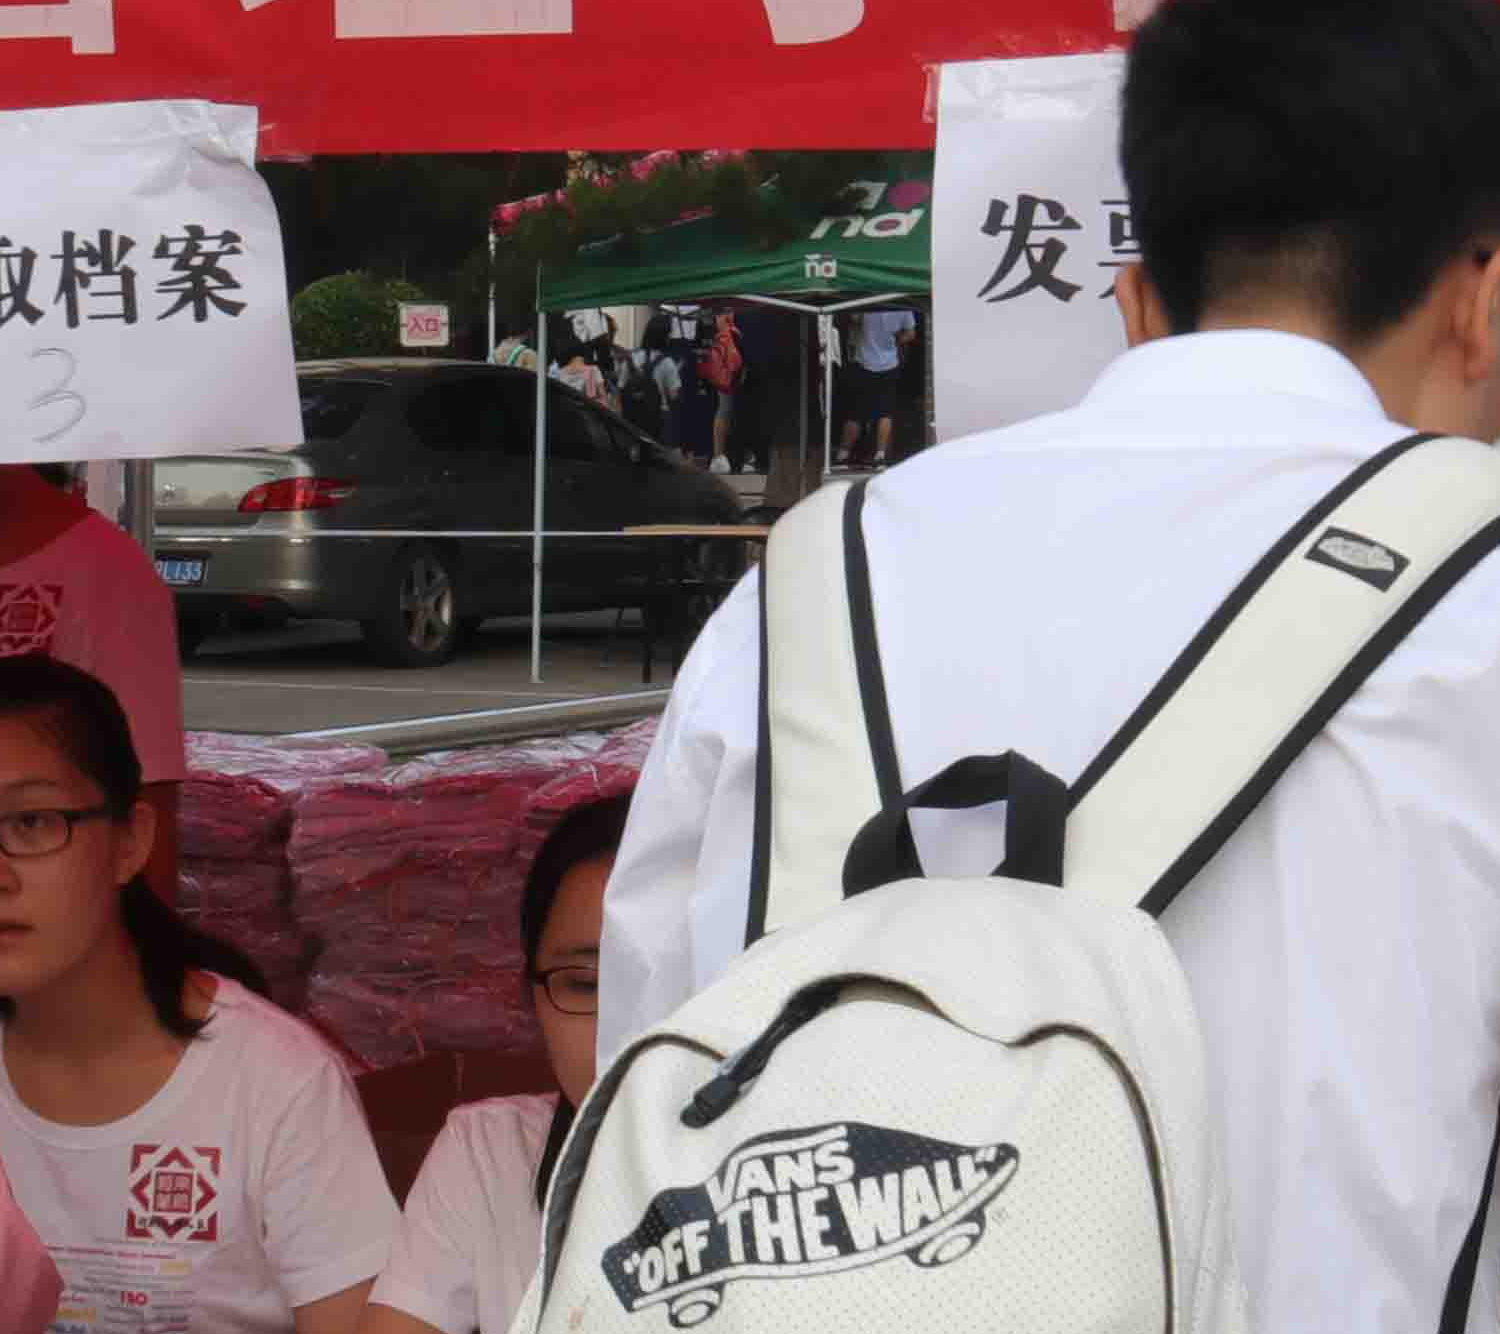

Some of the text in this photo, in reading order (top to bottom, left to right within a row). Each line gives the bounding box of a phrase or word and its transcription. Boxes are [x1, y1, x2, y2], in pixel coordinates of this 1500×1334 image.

[26, 347, 88, 444] 3
[705, 1127, 856, 1214] VANS
[719, 1188, 840, 1266] THE
